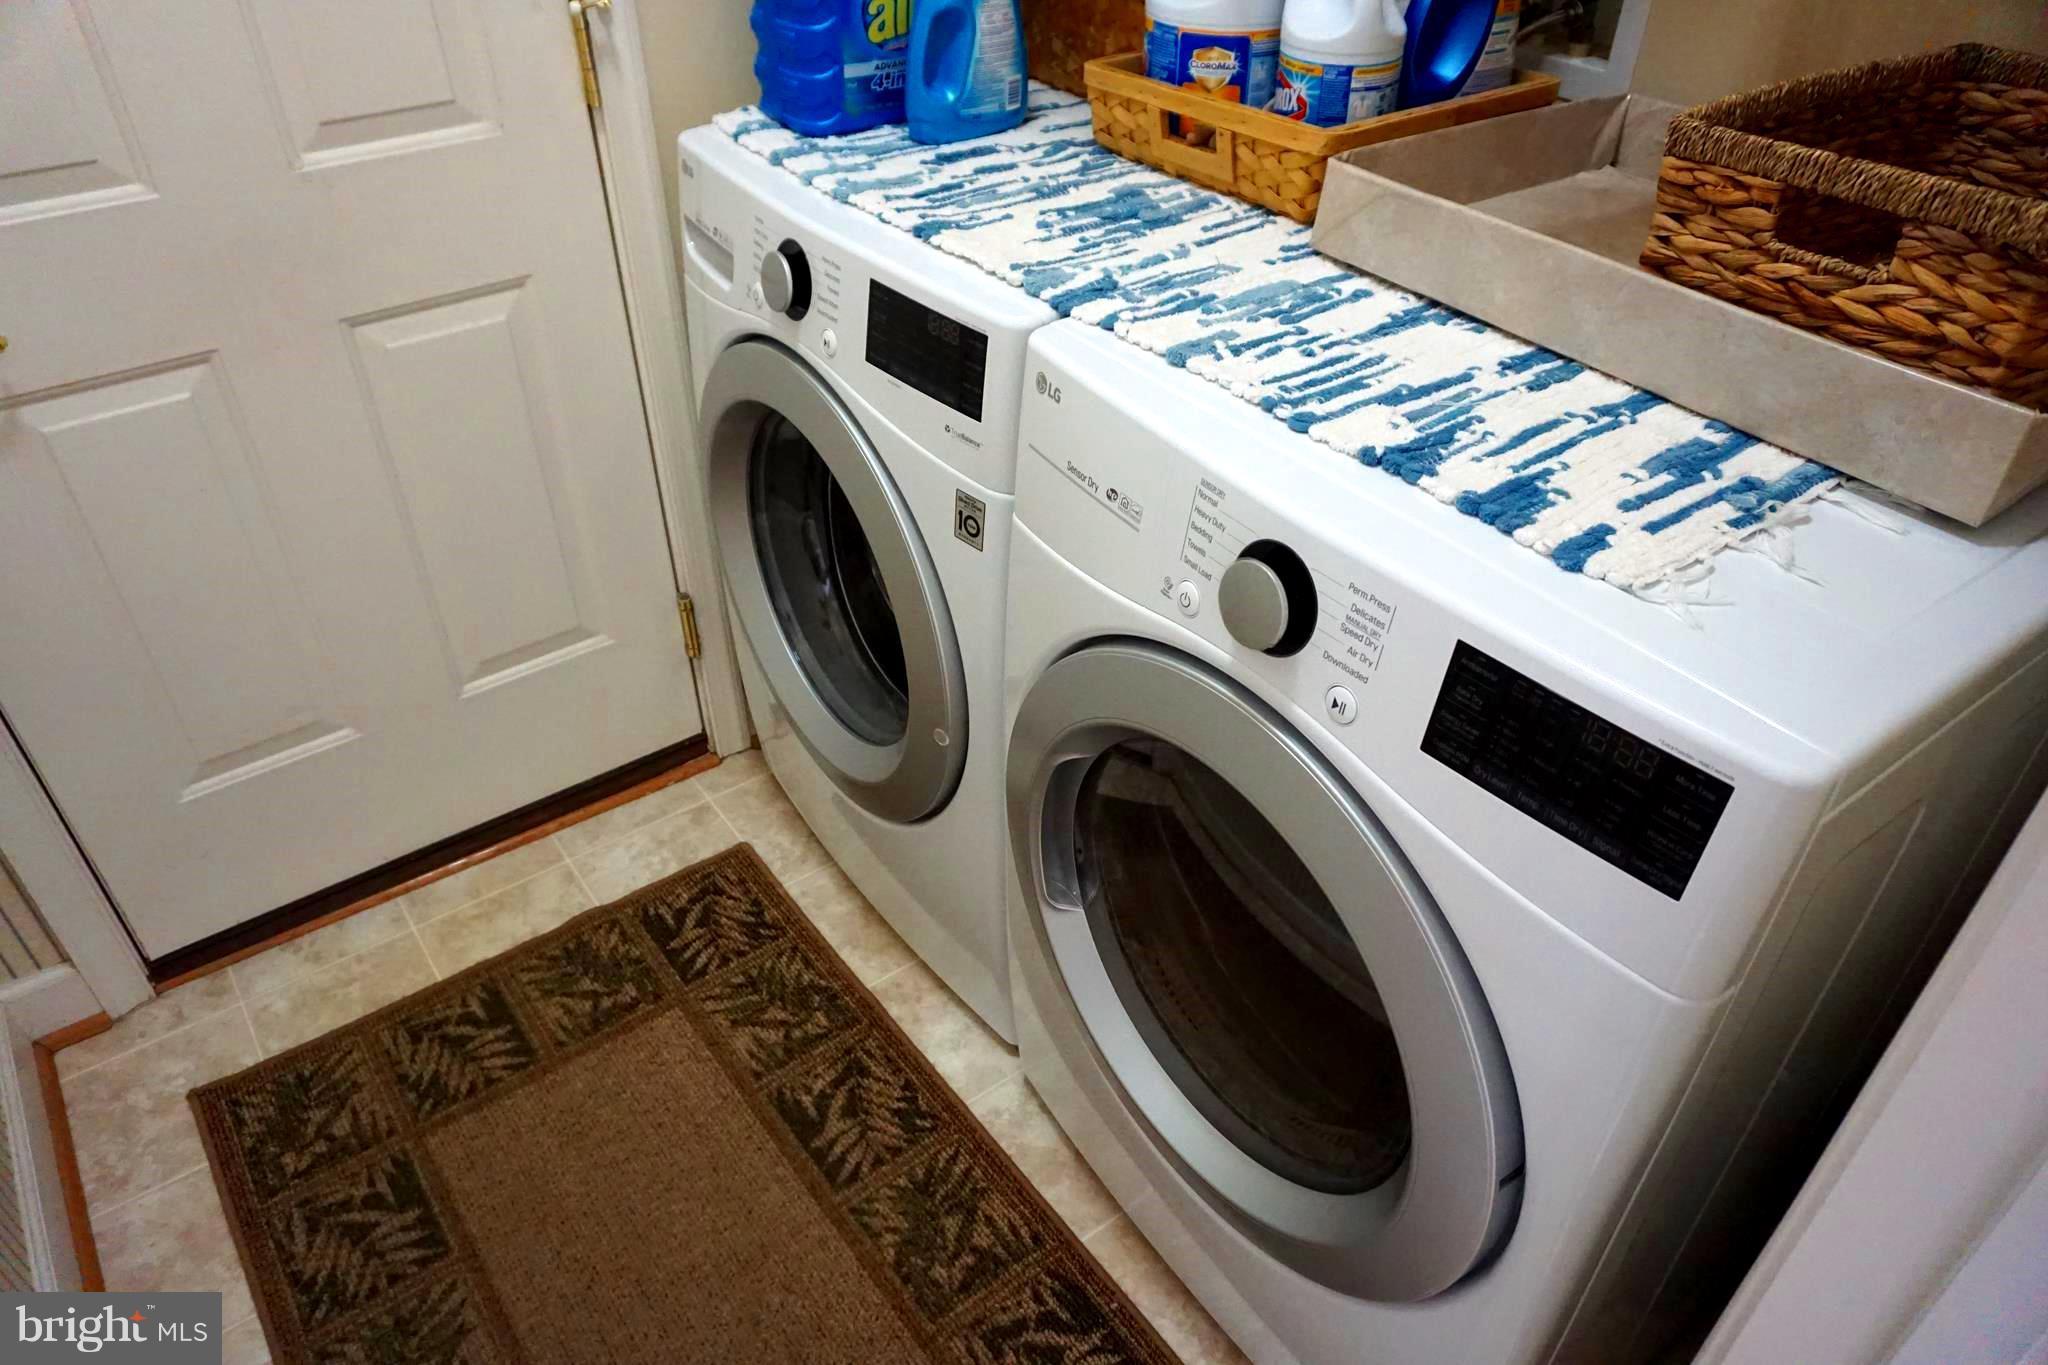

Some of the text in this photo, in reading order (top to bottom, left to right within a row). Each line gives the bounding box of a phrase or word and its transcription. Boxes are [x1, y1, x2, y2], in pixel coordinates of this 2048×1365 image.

[867, 0, 913, 44] al
[874, 59, 907, 71] ADVAN
[1047, 381, 1062, 404] LG
[1066, 460, 1100, 494] Sensor Dry
[958, 509, 981, 538] 10
[1190, 520, 1214, 543] Bedding
[1350, 603, 1386, 630] Delicates
[1340, 622, 1379, 652] Speed Dry
[1322, 649, 1369, 684] Downloaded
[1346, 645, 1374, 669] Air Dry
